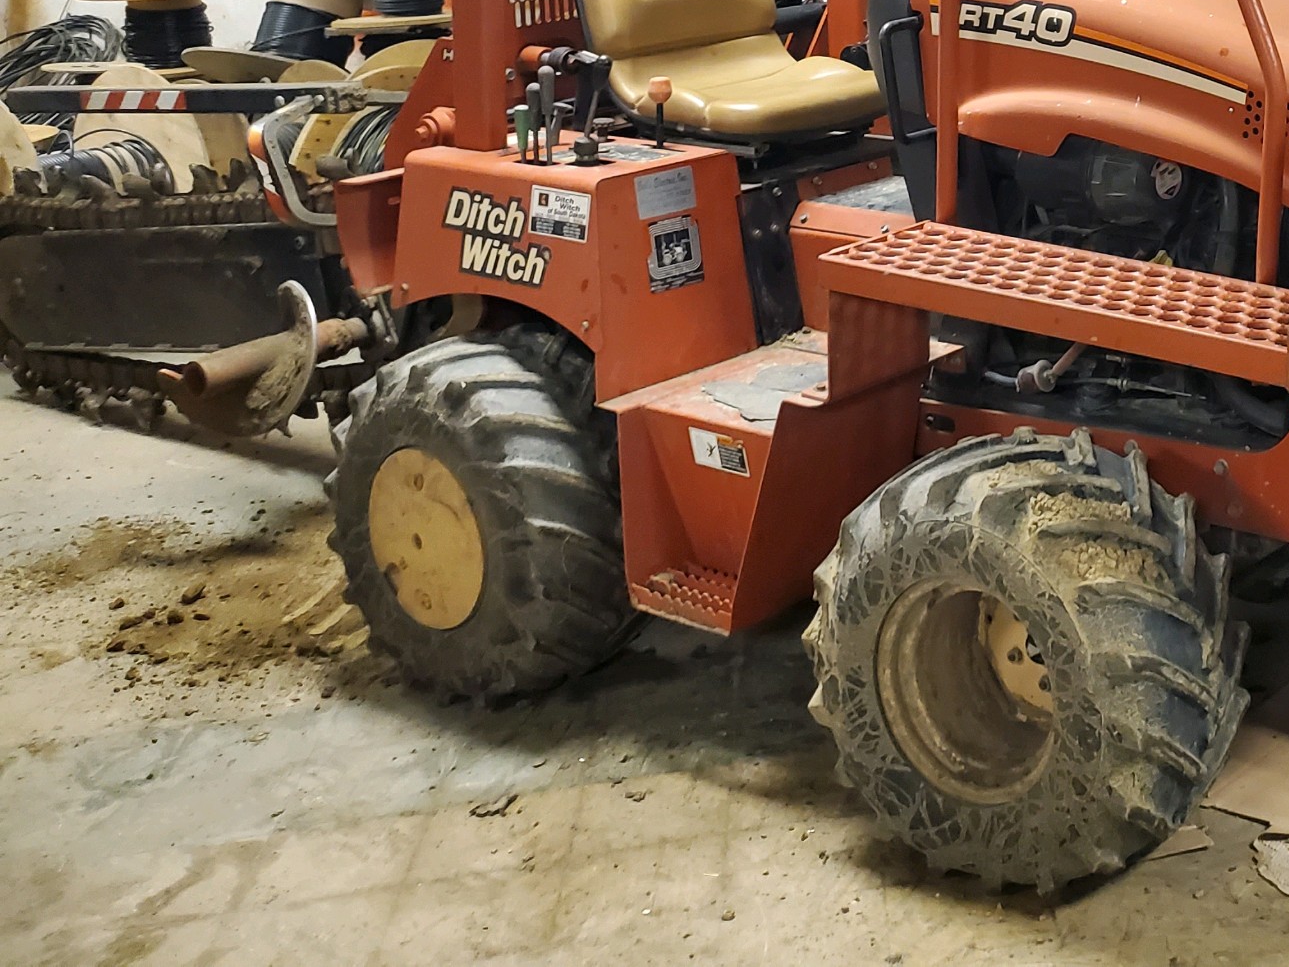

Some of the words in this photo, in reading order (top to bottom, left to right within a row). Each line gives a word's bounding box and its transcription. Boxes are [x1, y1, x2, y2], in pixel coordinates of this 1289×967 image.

[959, 3, 1073, 43] RT40
[445, 190, 525, 238] Ditch
[555, 195, 575, 204] Ditch
[560, 204, 581, 212] Witch
[461, 234, 545, 285] Witch
